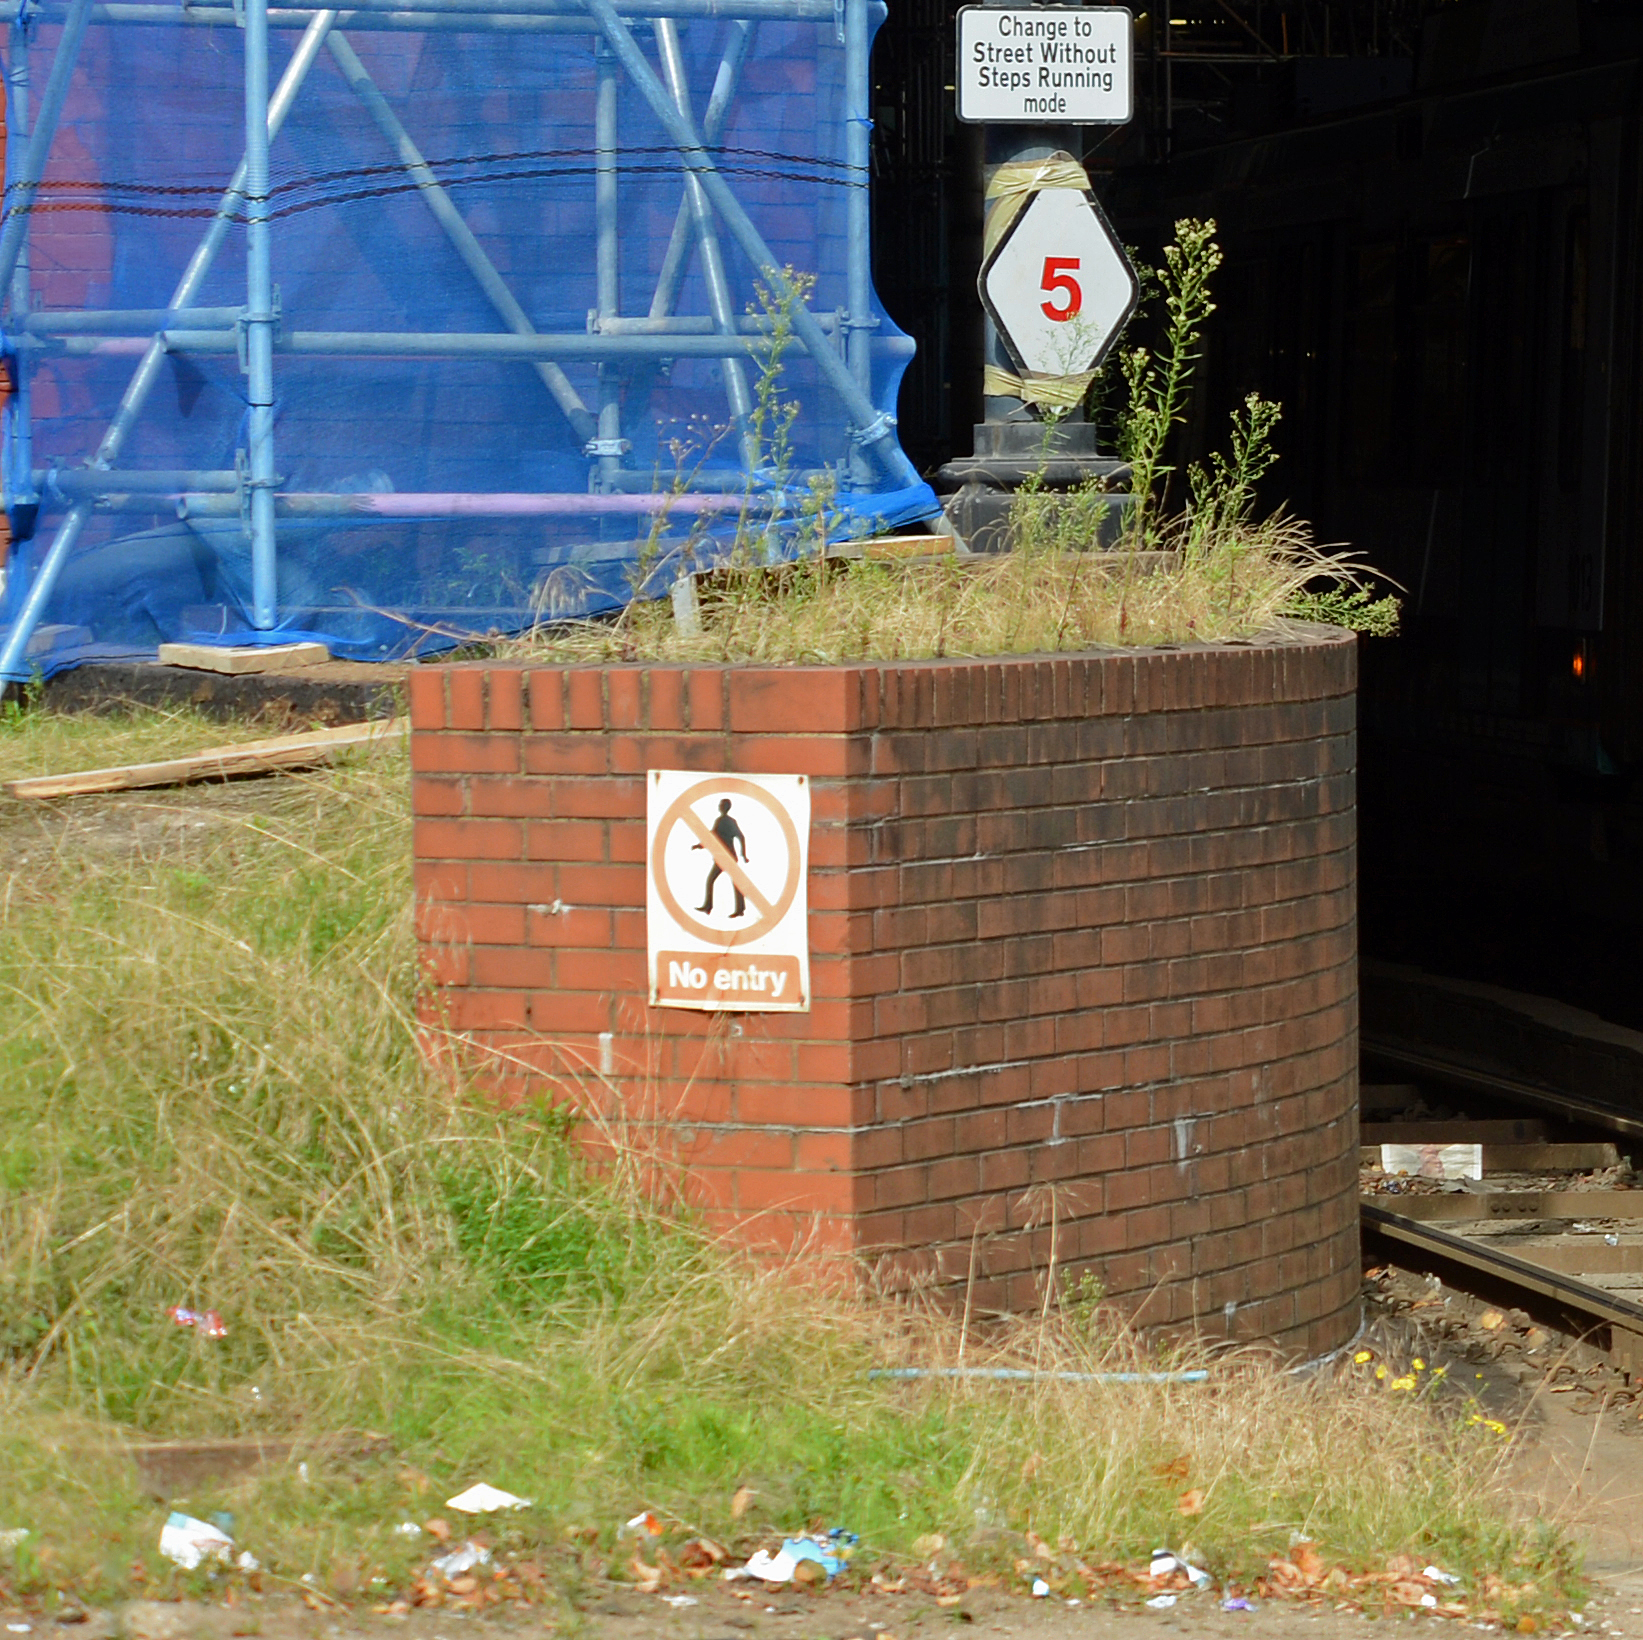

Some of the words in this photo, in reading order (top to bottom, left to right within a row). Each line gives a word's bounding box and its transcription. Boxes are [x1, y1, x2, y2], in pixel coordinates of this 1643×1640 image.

[998, 15, 1067, 40] Change
[1073, 16, 1092, 37] to
[973, 42, 1033, 64] Street
[1040, 42, 1117, 64] Without
[978, 66, 1031, 91] Steps
[1038, 66, 1113, 92] Running
[1024, 92, 1067, 114] mode
[1040, 257, 1082, 322] 5
[669, 960, 707, 989] No
[713, 963, 788, 998] entry
